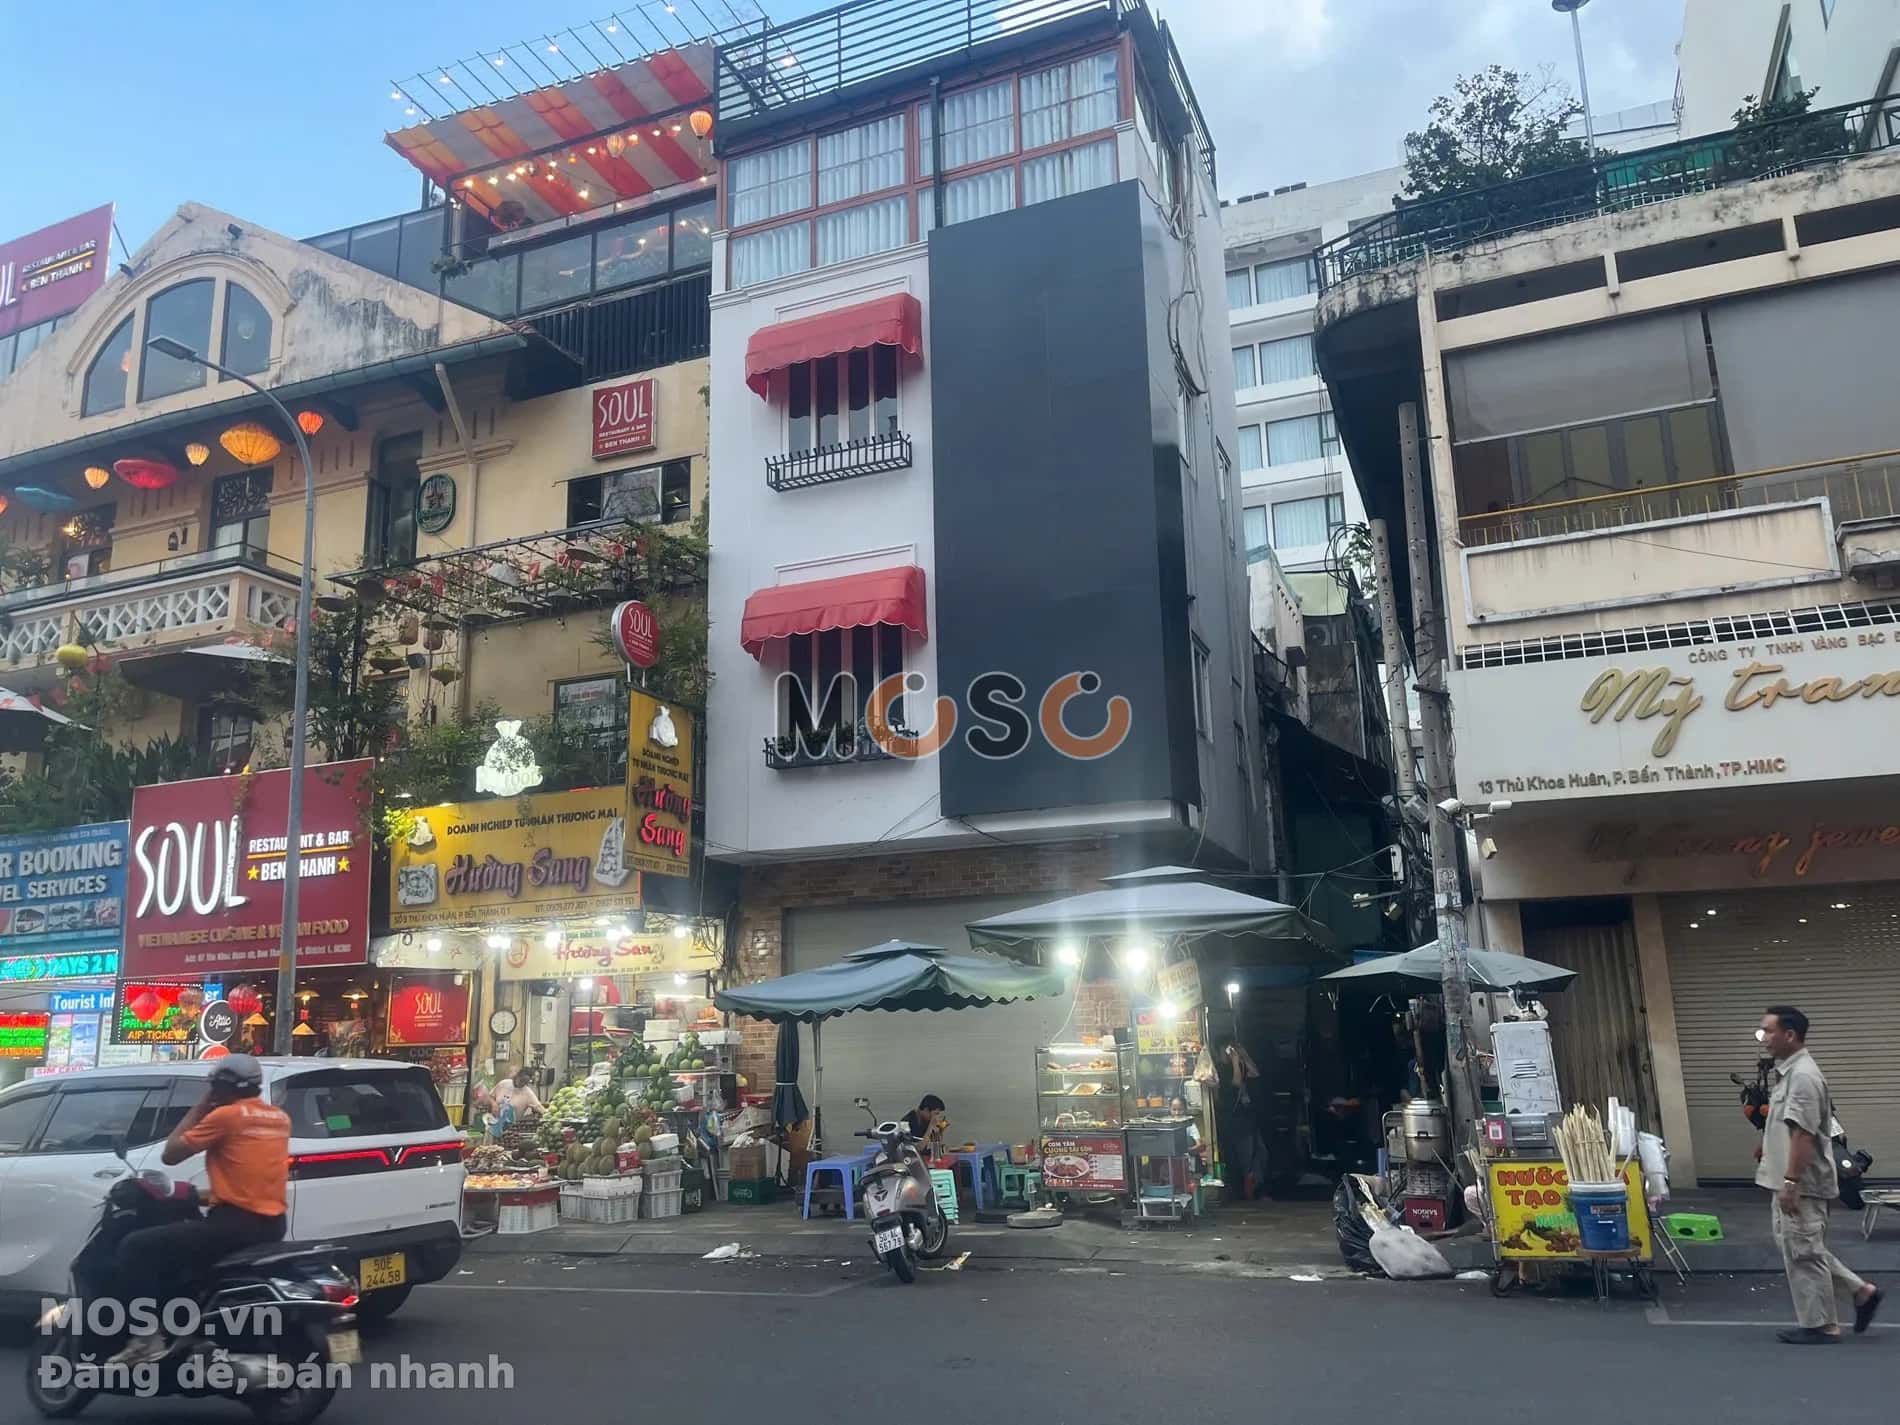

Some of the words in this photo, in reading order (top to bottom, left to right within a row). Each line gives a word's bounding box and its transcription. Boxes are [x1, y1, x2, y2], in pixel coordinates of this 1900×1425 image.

[598, 385, 648, 429] SOUL
[628, 607, 653, 638] SOUL
[1688, 648, 1728, 664] CÔNG
[1738, 646, 1756, 659] TY
[1765, 641, 1804, 656] TNHH
[1811, 634, 1848, 651] VÀNG
[1858, 632, 1885, 648] BẠC
[1581, 667, 1703, 758] Mỹ
[1478, 778, 1494, 795] 13
[249, 832, 314, 853] RESTAUNT
[328, 830, 350, 845] BAR
[447, 823, 480, 836] DOANH
[640, 812, 686, 856] Sang
[18, 840, 122, 877] BOOKING
[136, 815, 246, 918] SOUL
[261, 861, 287, 881] BEN
[299, 856, 336, 878] HANH
[444, 854, 523, 898] Hường
[526, 847, 592, 893] Sang
[27, 874, 107, 899] SERVICES
[313, 919, 350, 936] FOOD
[54, 992, 96, 1011] Tourist
[415, 991, 443, 1015] SOUL
[1505, 1189, 1561, 1209] TẠO
[374, 1257, 393, 1272] 50E
